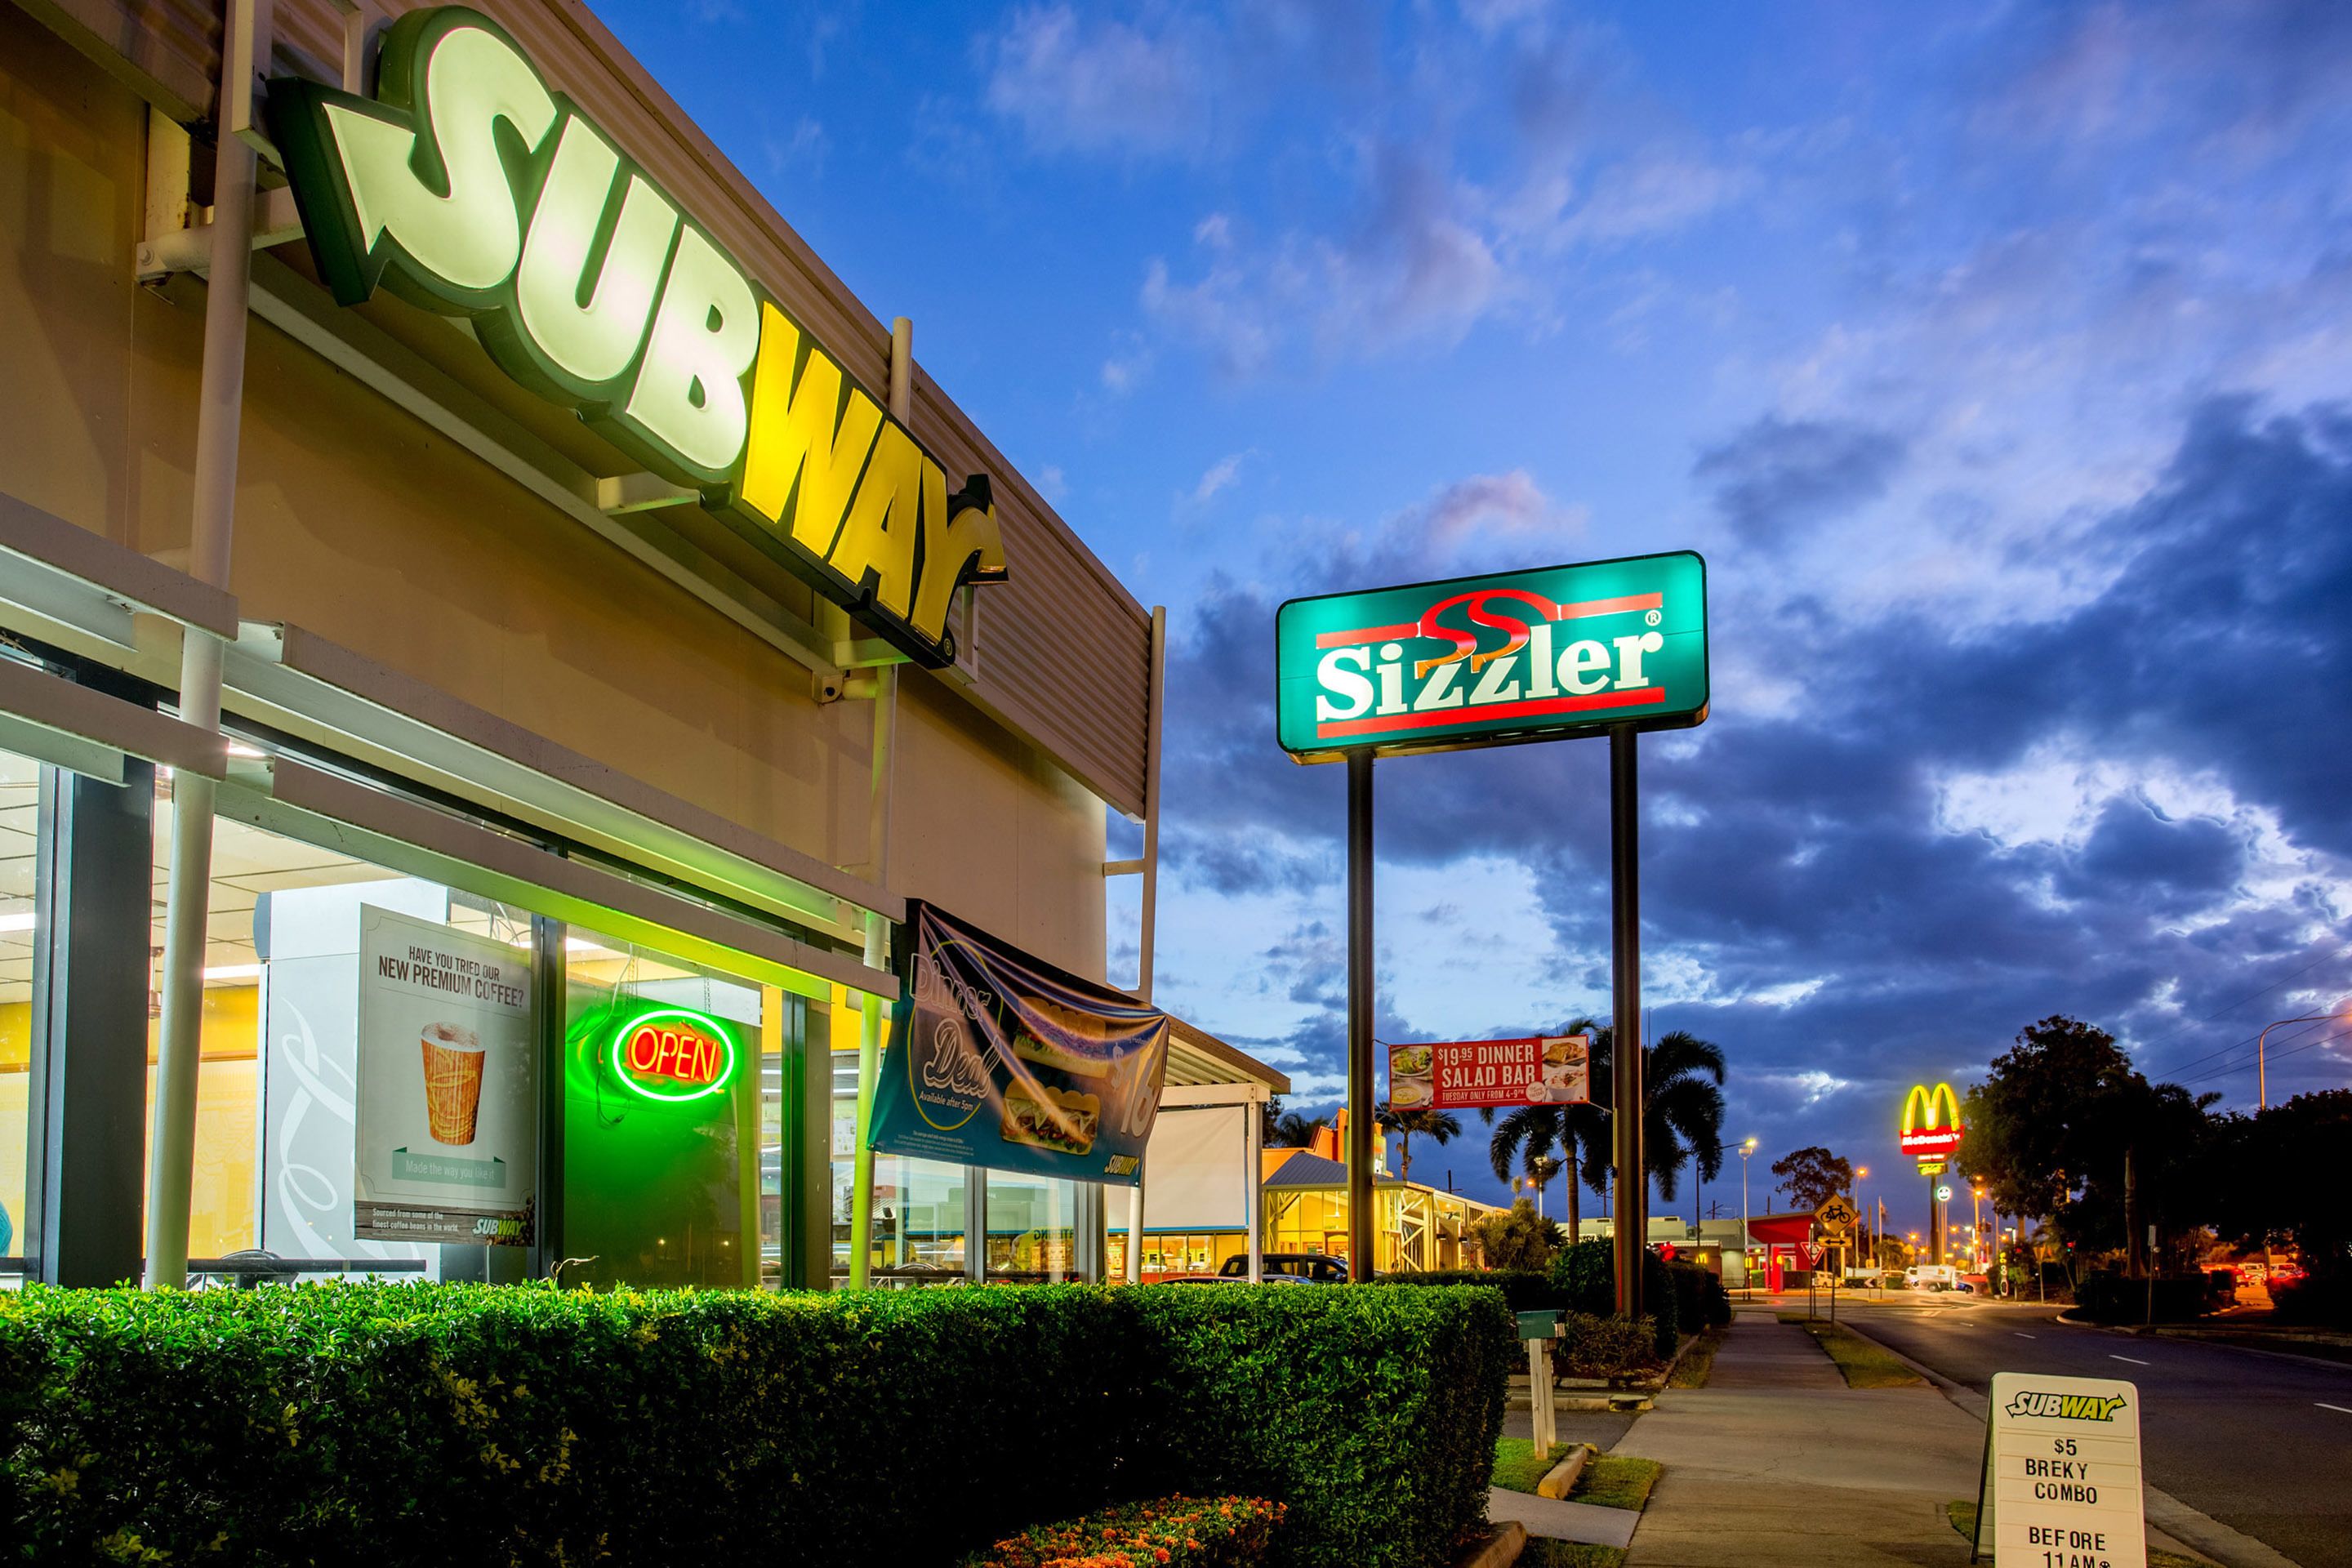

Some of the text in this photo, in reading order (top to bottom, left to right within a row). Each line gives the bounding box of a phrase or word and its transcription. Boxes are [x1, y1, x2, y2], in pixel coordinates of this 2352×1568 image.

[322, 25, 1006, 645] SUBWAY
[1316, 624, 1664, 722] Sizzler
[409, 946, 500, 981] HAVE YOU TRIED OUR
[379, 956, 524, 1008] NEW PREMIUM COFFEE?
[909, 953, 991, 1022] Dinner
[630, 1027, 717, 1082] OPEN
[1437, 1044, 1535, 1067] $19.95 DINNER
[1441, 1064, 1535, 1089] SALAD BAR
[919, 1090, 973, 1111] Available after 5pm
[1442, 1091, 1468, 1102] TUESDAY
[1470, 1090, 1486, 1100] ONLY
[1487, 1089, 1504, 1099] FROM
[406, 1160, 428, 1174] Made
[430, 1162, 442, 1175] the
[444, 1166, 458, 1178] way
[459, 1168, 473, 1179] you
[1104, 1153, 1139, 1176] SUBWAY
[372, 1208, 396, 1217] Sourced
[398, 1209, 411, 1218] from
[427, 1211, 434, 1219] of
[434, 1211, 443, 1220] the
[372, 1219, 389, 1228] finest
[390, 1220, 408, 1229] coffee
[409, 1222, 425, 1230] beans
[434, 1223, 442, 1231] the
[472, 1218, 525, 1236] SUBWAY
[2006, 1391, 2127, 1422] SUBWAY
[2054, 1438, 2077, 1456] $5
[2034, 1482, 2097, 1504] COMBO
[2029, 1526, 2105, 1551] BEFORE
